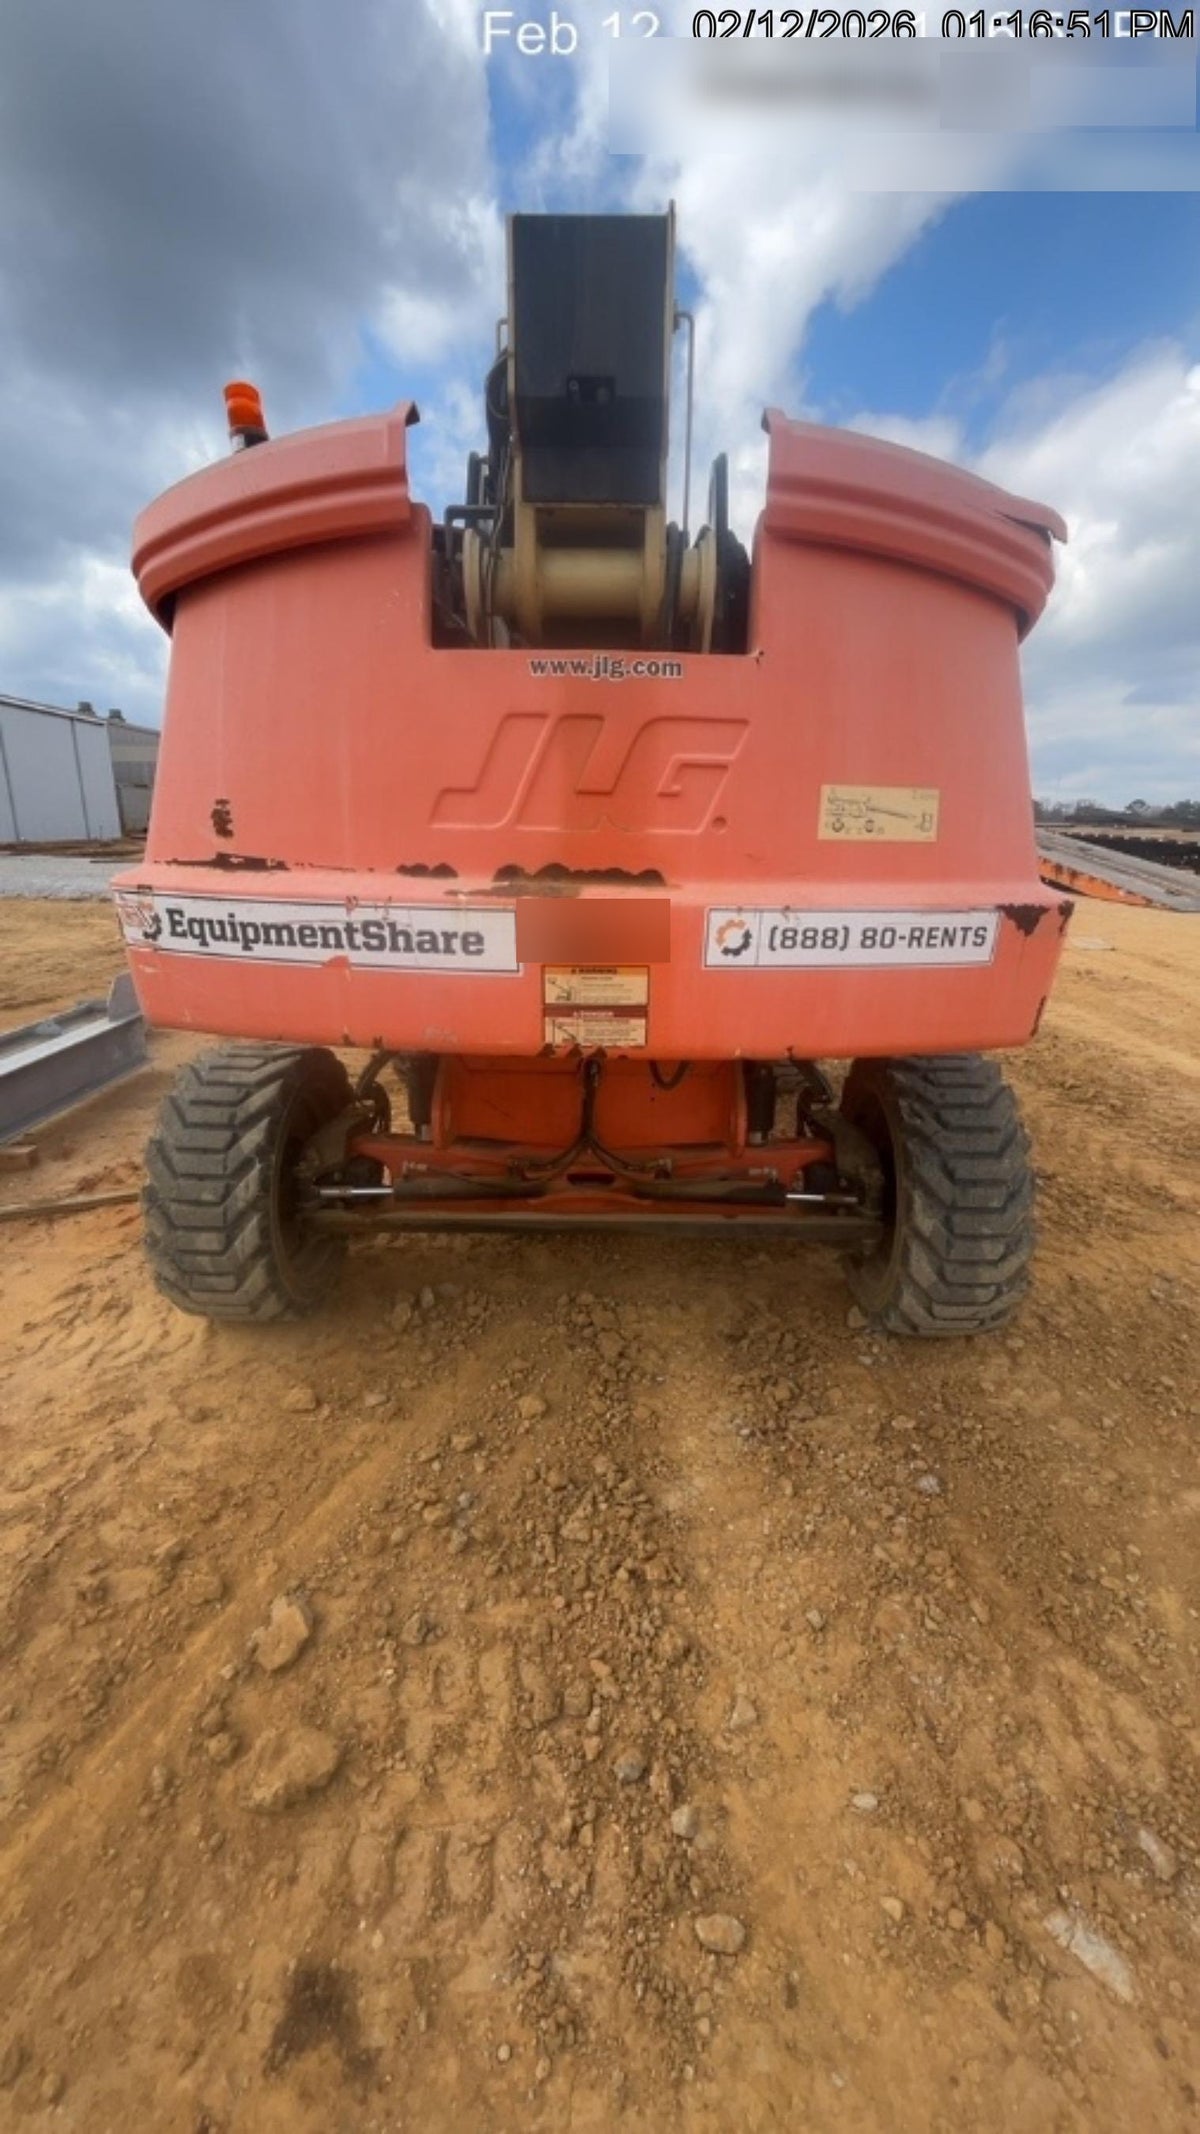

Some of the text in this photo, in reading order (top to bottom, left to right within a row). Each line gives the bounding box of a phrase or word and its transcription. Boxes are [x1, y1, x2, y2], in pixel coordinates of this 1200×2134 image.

[530, 656, 682, 680] www.jlg.com
[429, 712, 749, 836] JLG
[165, 907, 486, 957] EquipmentShare
[767, 925, 988, 951] (888) 80-RENTS
